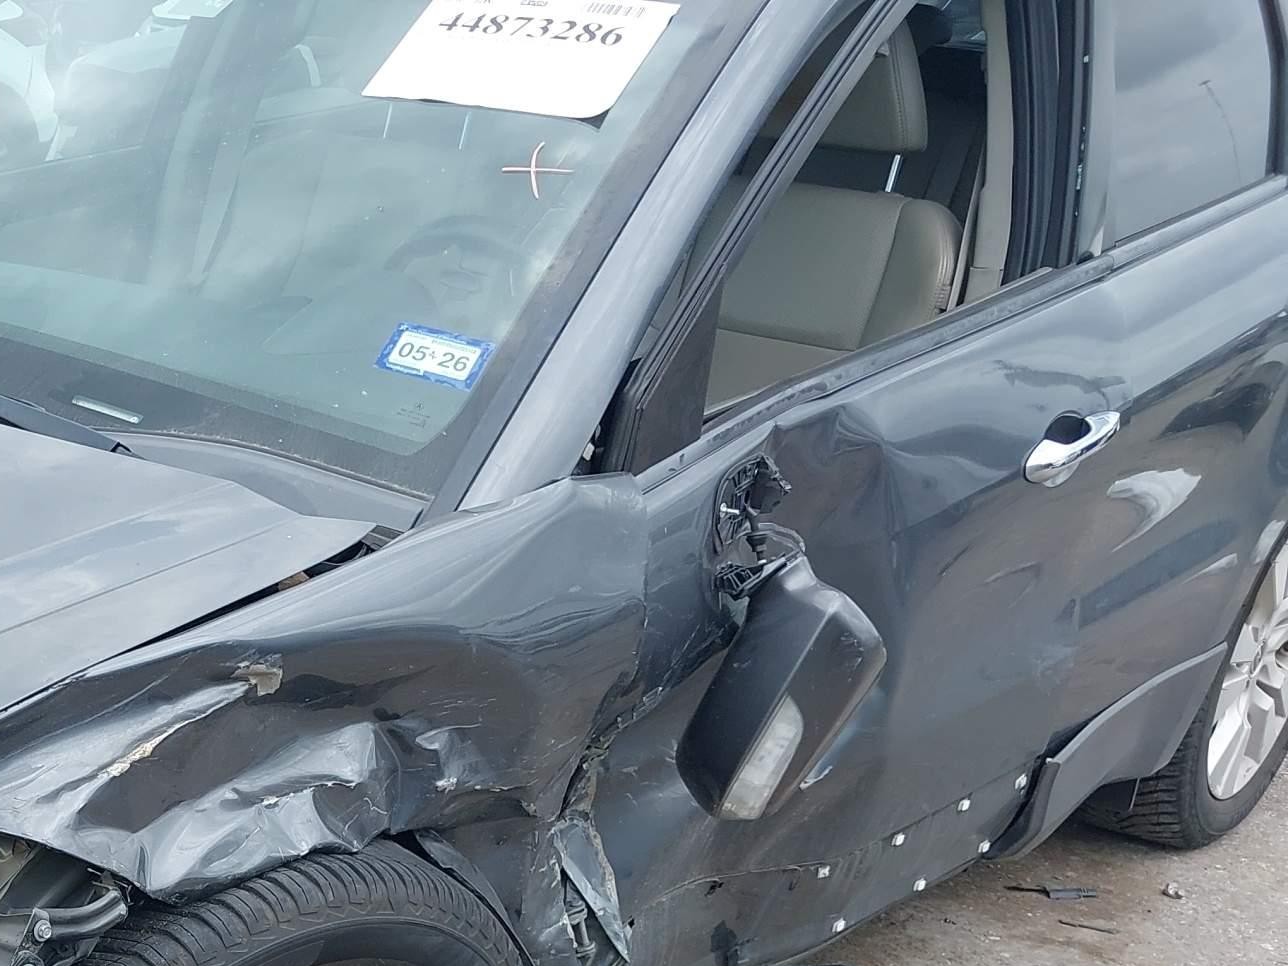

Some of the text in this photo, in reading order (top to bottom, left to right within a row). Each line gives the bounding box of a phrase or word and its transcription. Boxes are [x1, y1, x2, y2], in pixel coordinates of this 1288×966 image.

[438, 11, 625, 46] 44873286
[398, 342, 430, 361] 05
[437, 352, 470, 372] 26
